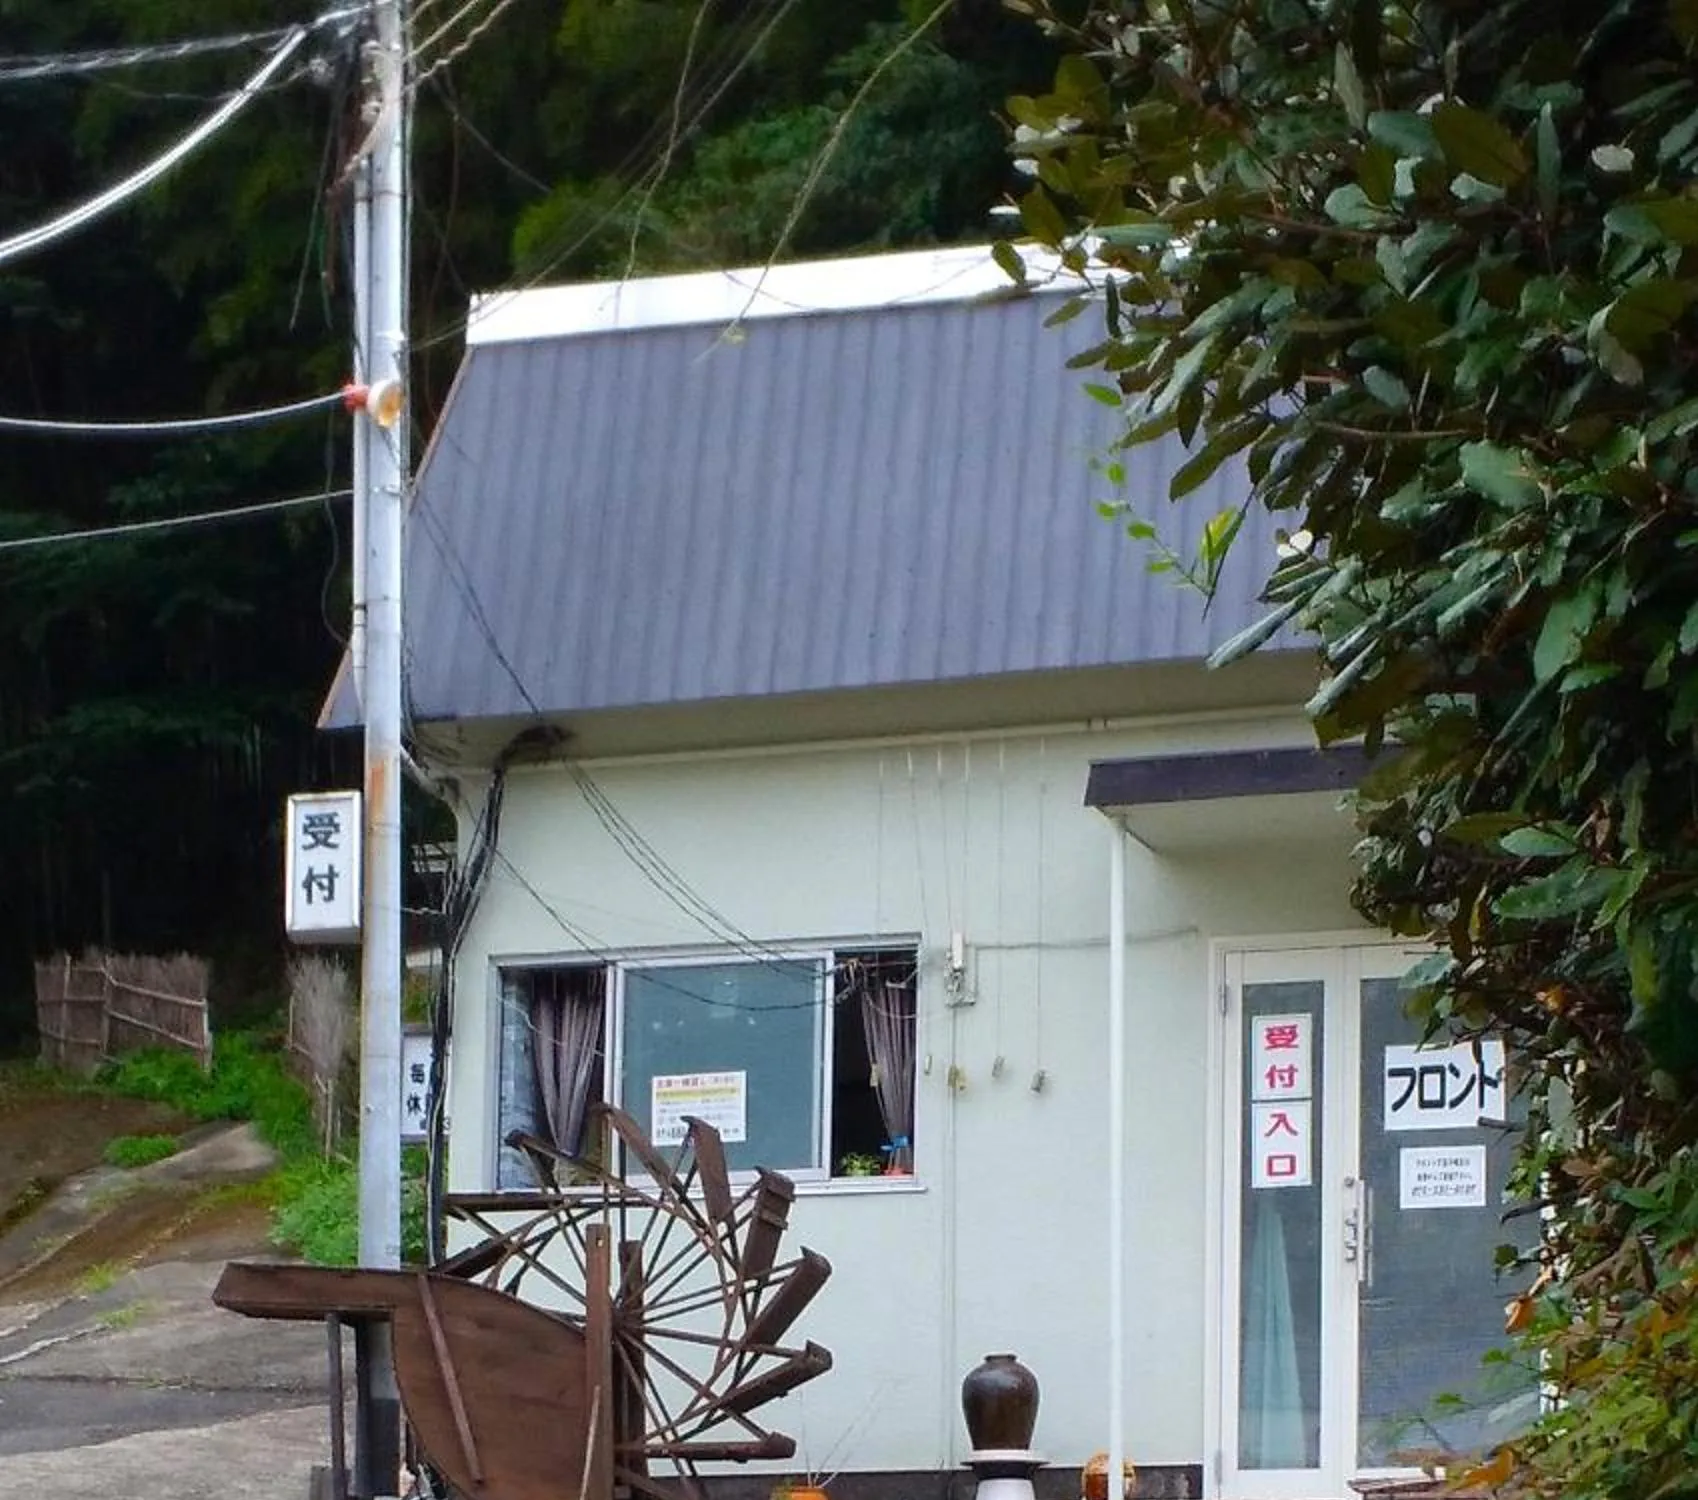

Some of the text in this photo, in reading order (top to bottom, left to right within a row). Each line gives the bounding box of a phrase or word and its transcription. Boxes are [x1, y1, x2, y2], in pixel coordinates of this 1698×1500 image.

[302, 811, 340, 905] 受付
[1264, 1023, 1299, 1177] 受付 入口
[1388, 1061, 1499, 1112] フロント
